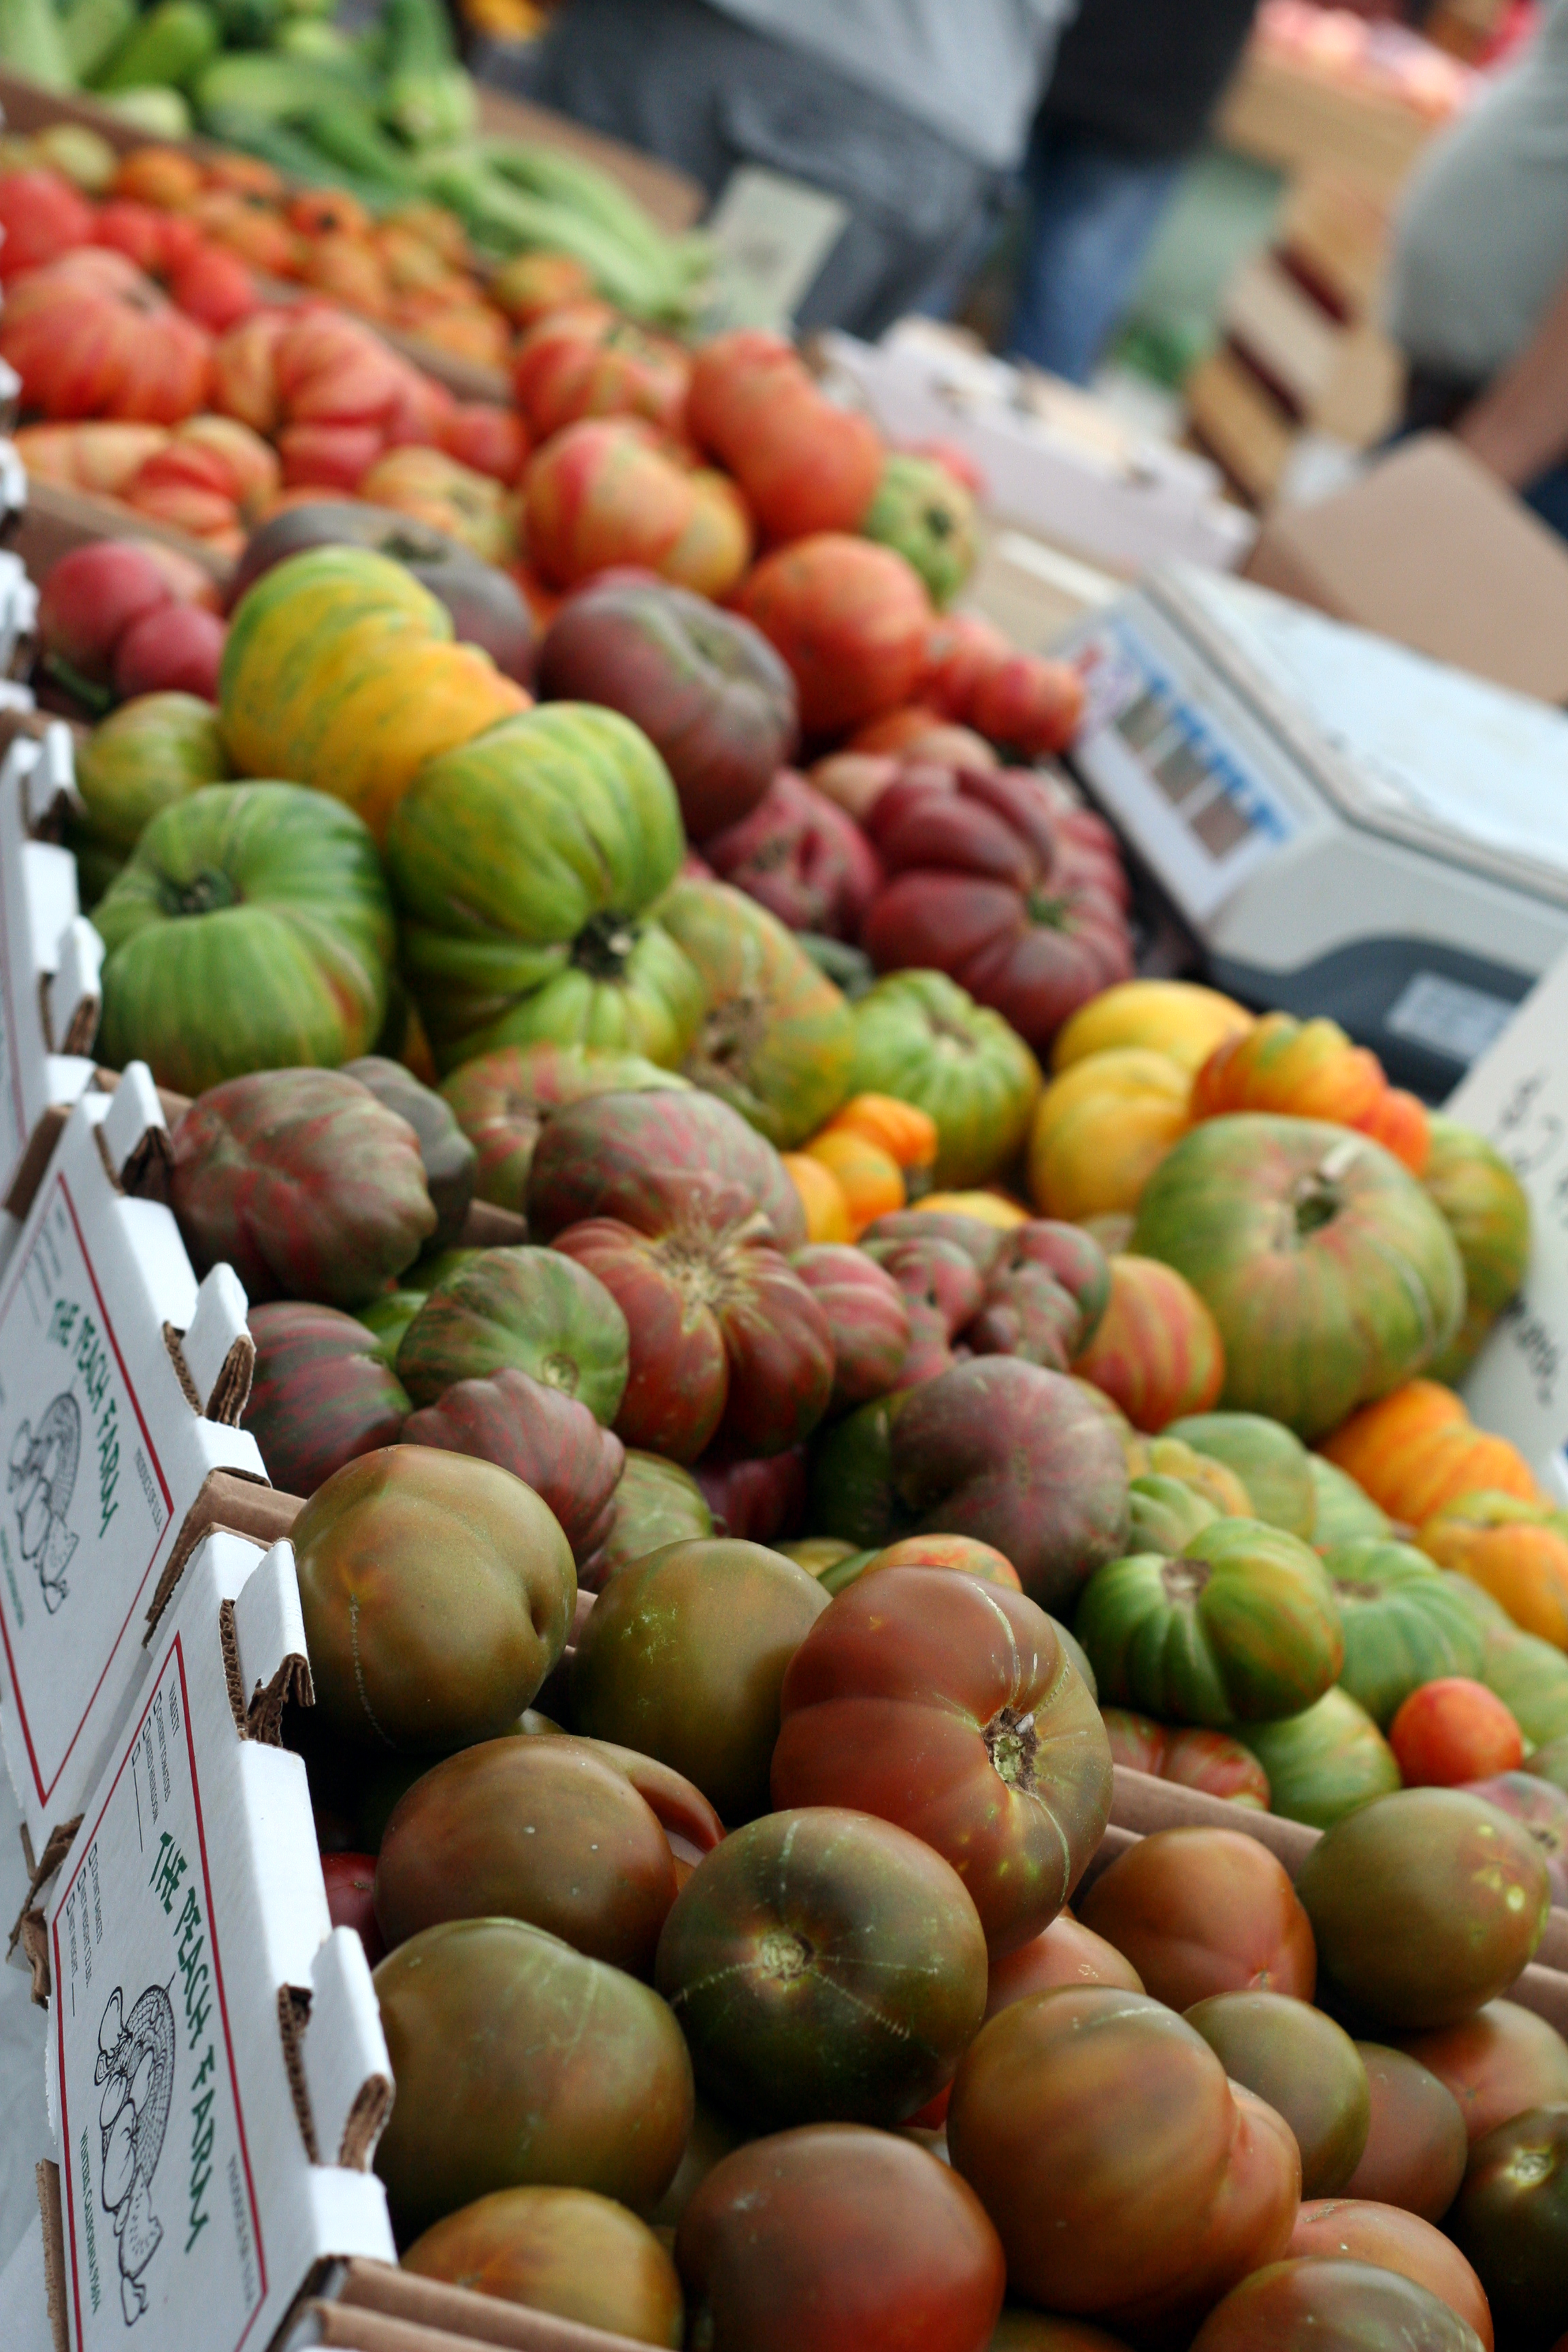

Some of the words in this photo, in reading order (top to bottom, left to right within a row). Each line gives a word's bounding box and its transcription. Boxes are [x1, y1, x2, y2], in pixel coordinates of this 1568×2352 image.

[48, 1298, 80, 1348] THE
[74, 1315, 110, 1414] PEACH
[97, 1398, 120, 1539] FARM
[169, 1680, 180, 1737] VARIETY
[145, 1733, 153, 1769] MIXED
[156, 1707, 165, 1749] CHERRY
[161, 1744, 171, 1803] TOMATOES
[148, 1765, 159, 1825] HEIRLOOM
[148, 1831, 188, 1915] THE
[70, 1931, 78, 1978] WEIGHT
[95, 1897, 103, 1945] BASKETS
[174, 1886, 212, 2050] PEACH
[185, 2044, 215, 2253] FARM
